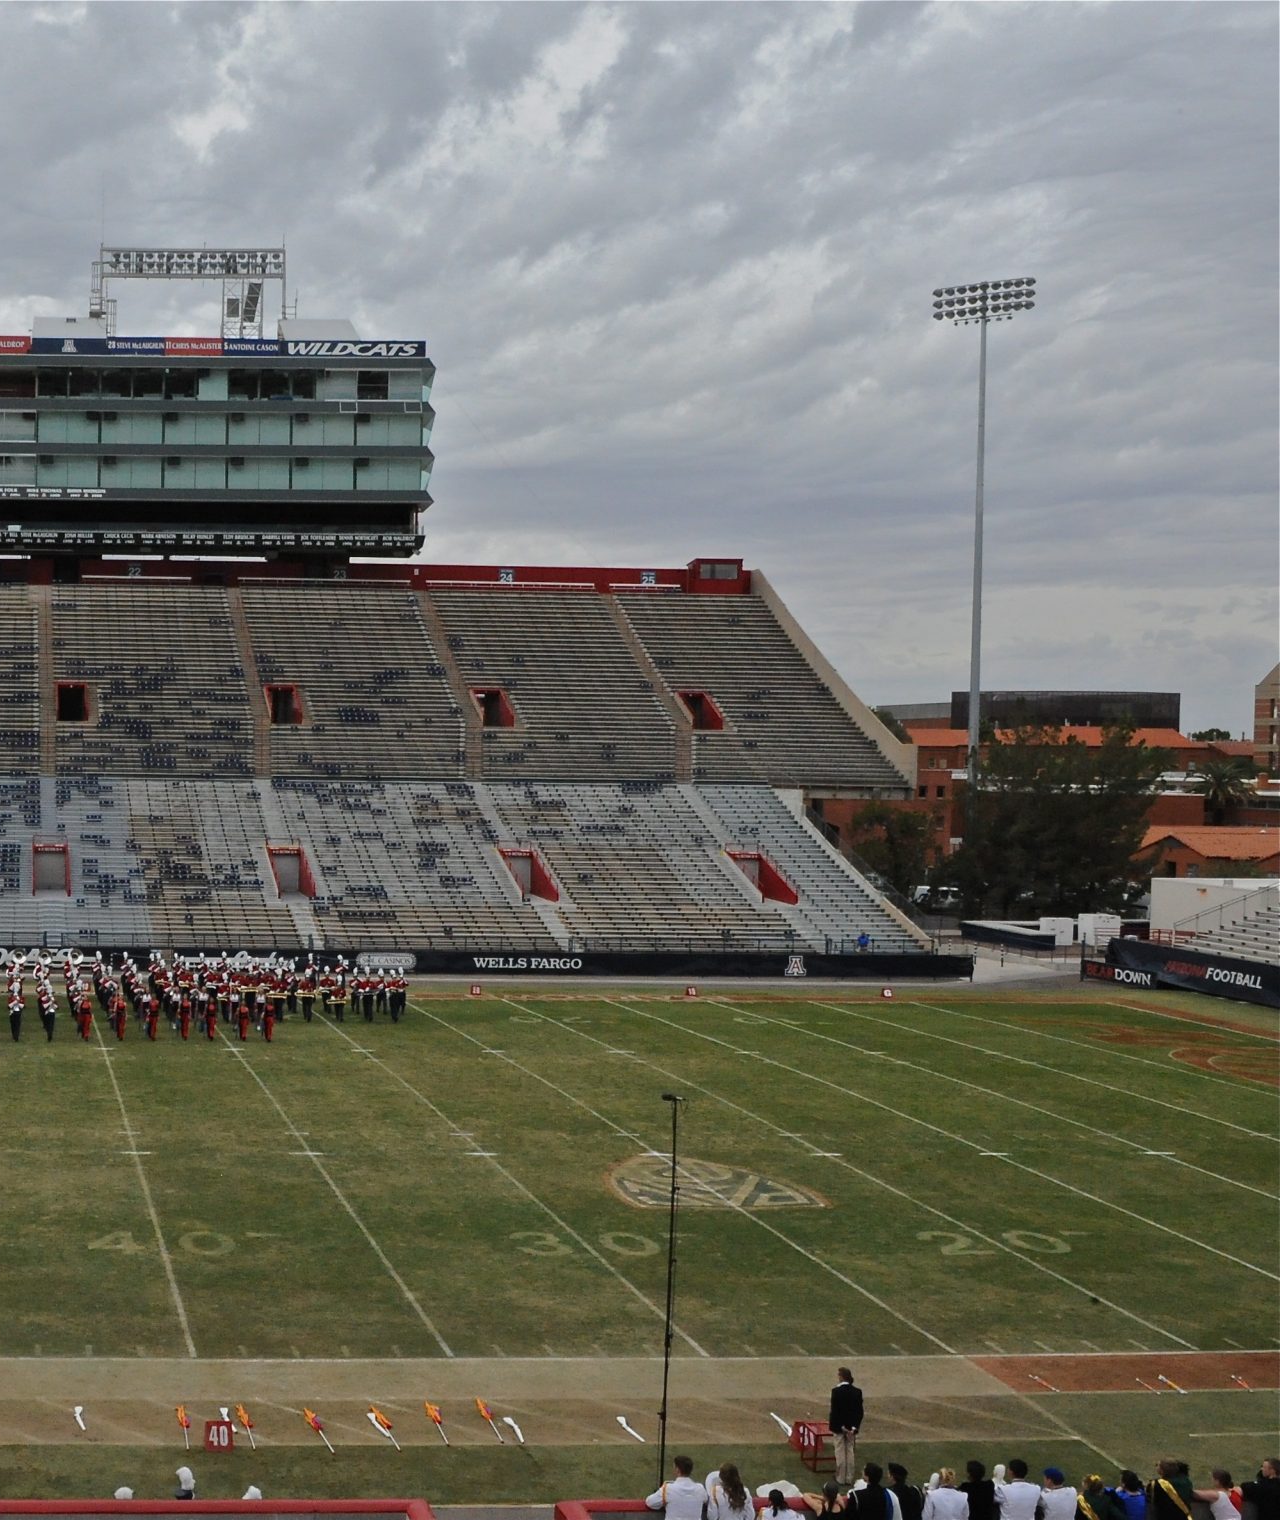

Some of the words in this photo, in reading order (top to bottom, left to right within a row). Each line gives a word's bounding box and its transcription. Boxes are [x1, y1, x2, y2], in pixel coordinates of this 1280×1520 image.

[132, 342, 164, 350] McLAUGHLIN
[166, 341, 171, 349] 11
[172, 342, 189, 350] CHRIS
[287, 343, 419, 356] WILDCATS
[129, 567, 141, 577] 22
[333, 570, 347, 580] 23
[501, 573, 513, 582] 24
[643, 576, 655, 585] 25
[473, 957, 527, 969] WELLS
[530, 958, 582, 969] FARGO
[785, 955, 806, 976] A
[1115, 968, 1151, 986] DOWN
[1205, 967, 1263, 990] FOOTBALL
[209, 1425, 228, 1446] 40
